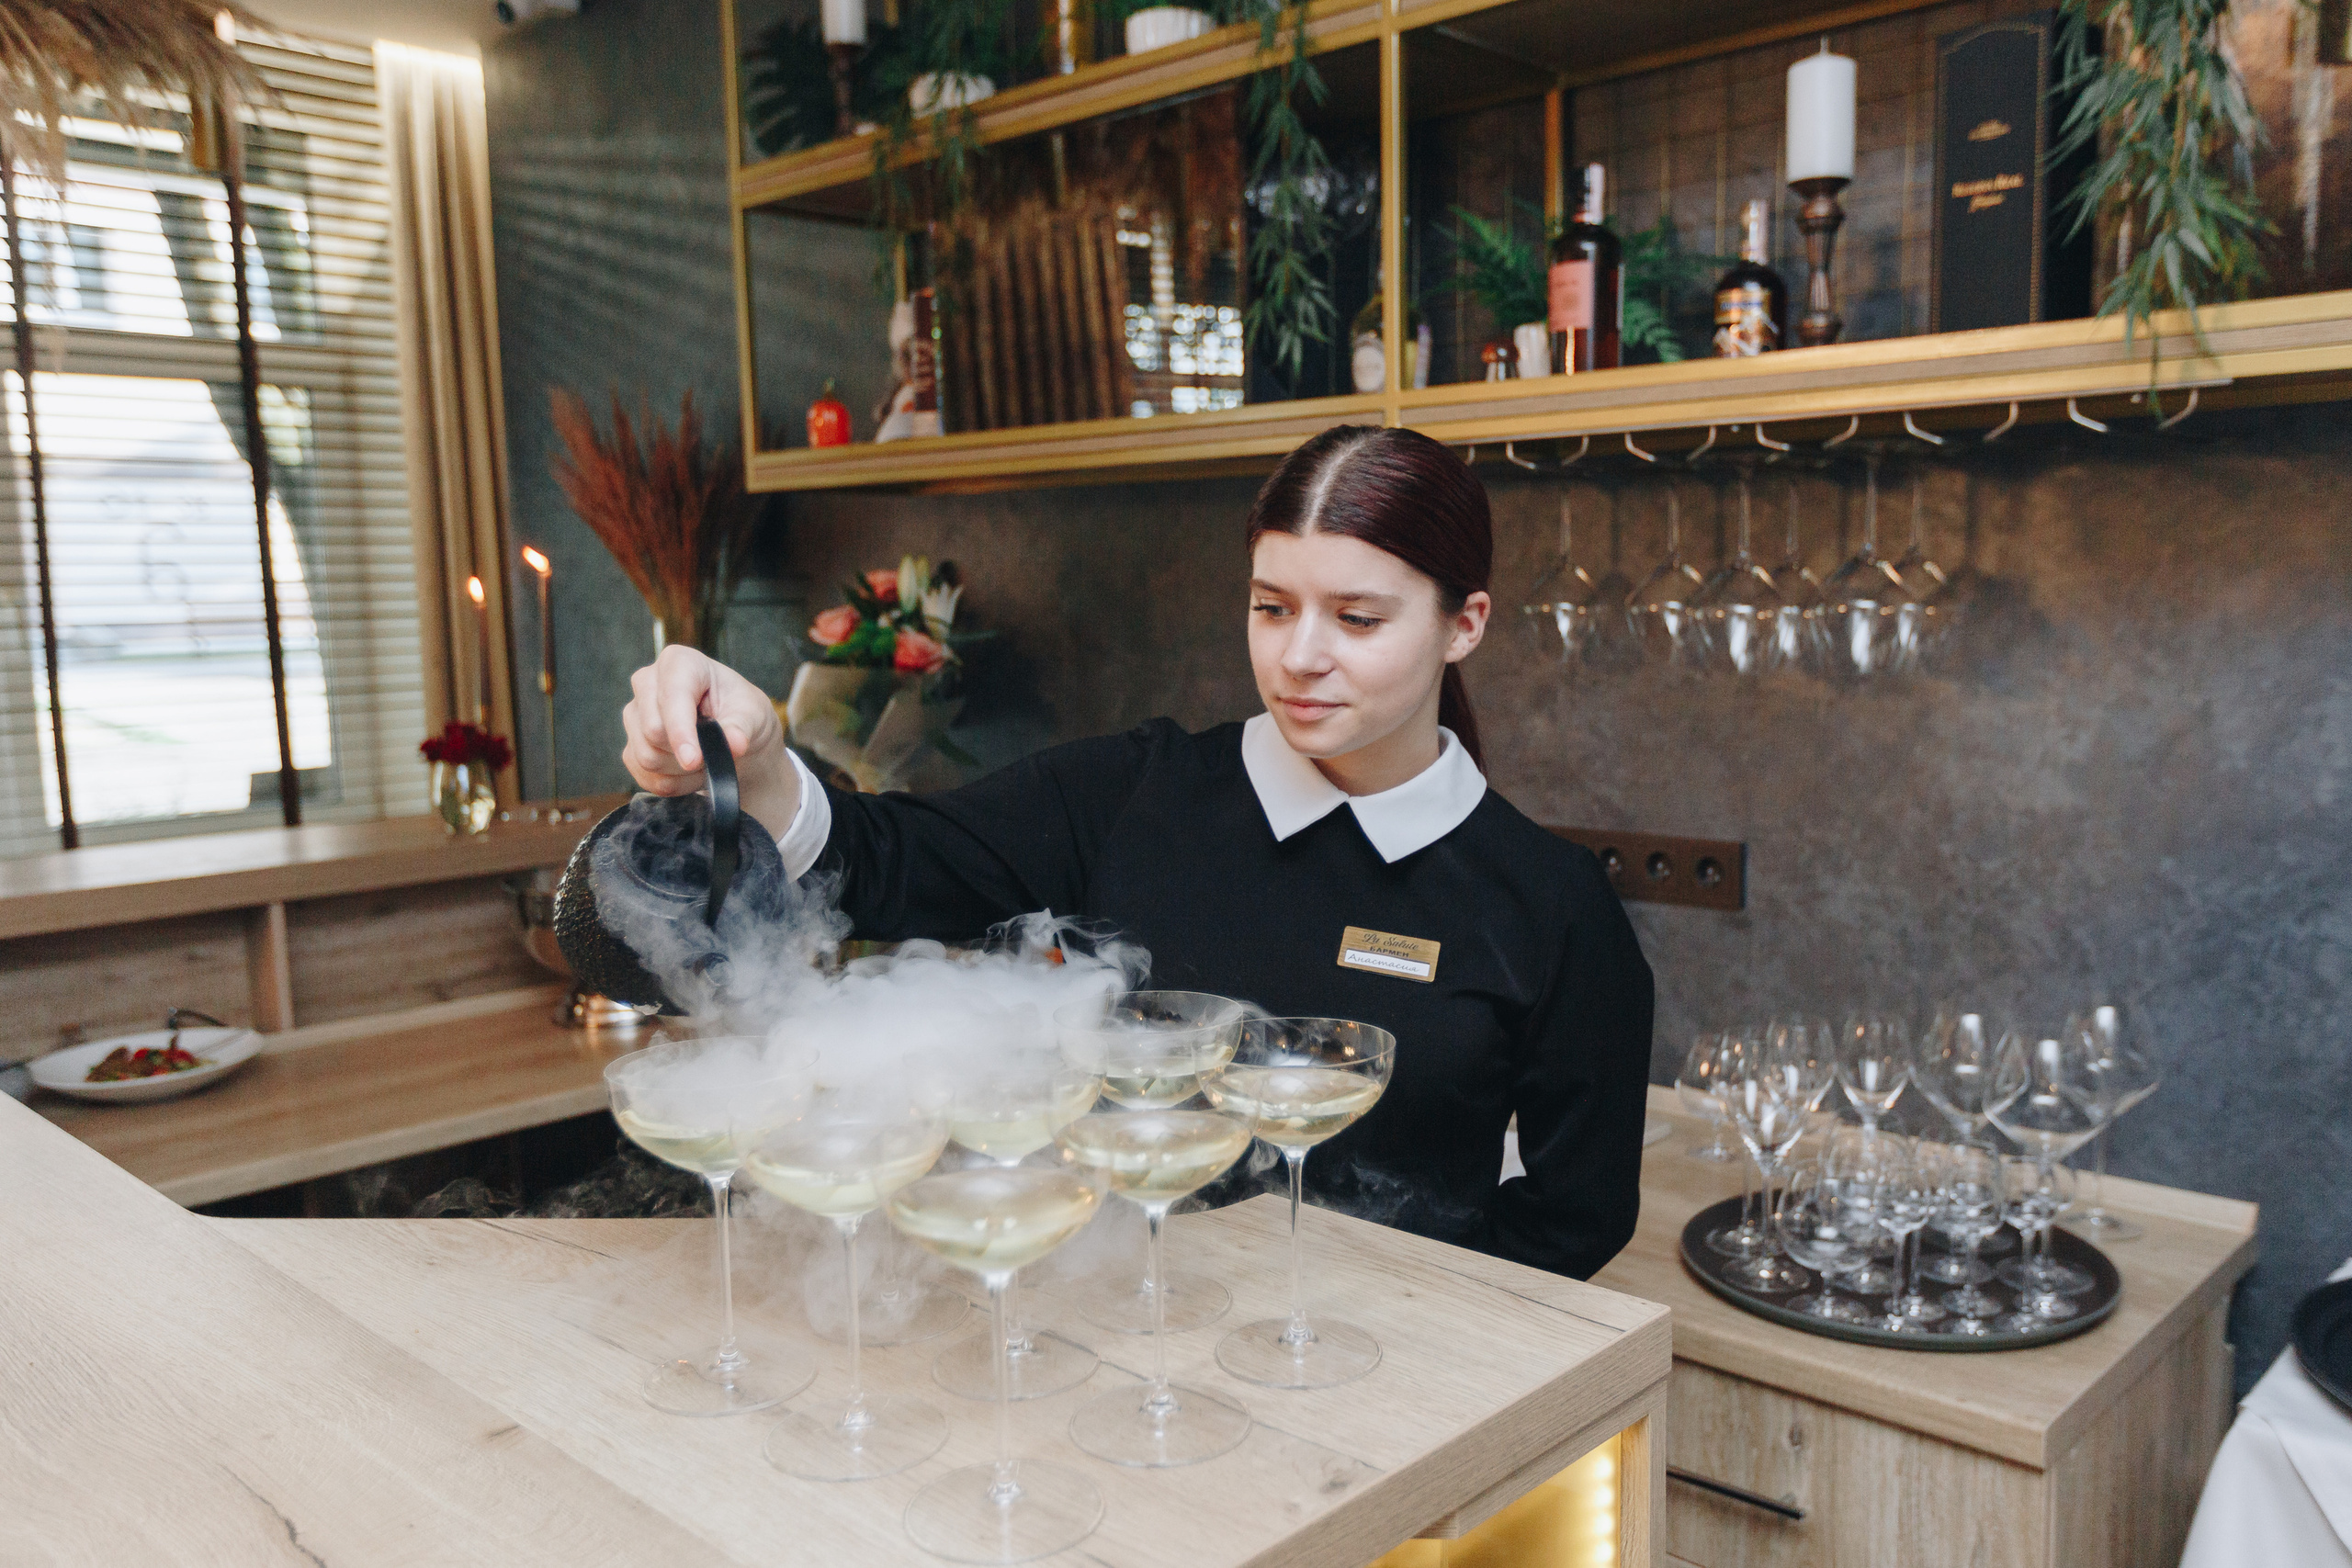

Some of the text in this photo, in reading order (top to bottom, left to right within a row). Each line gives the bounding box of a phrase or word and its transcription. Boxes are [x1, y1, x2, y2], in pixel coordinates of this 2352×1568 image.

[1383, 936, 1419, 950] Salute
[1370, 945, 1409, 957] БАРМЕН
[1347, 953, 1419, 972] Анастасия
